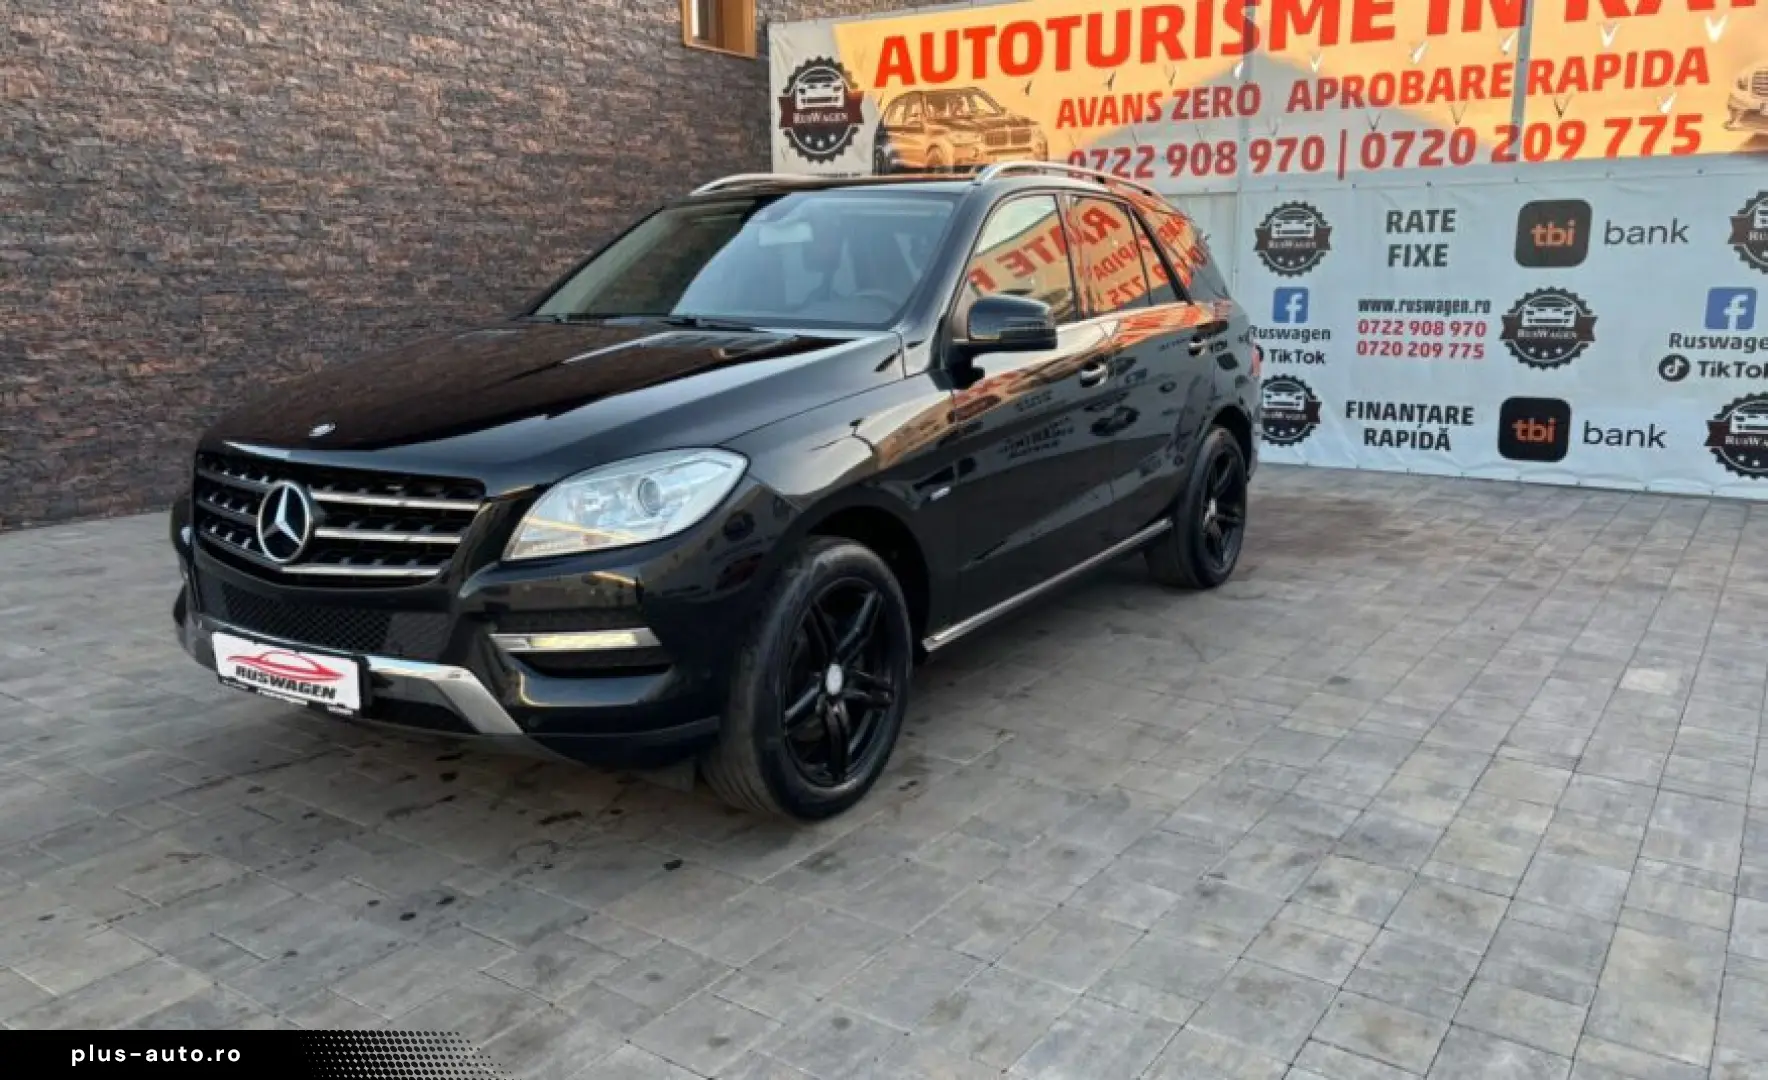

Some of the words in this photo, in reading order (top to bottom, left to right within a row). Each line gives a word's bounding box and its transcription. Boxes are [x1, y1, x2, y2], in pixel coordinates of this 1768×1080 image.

[874, 0, 1396, 87] AUTOTURISME
[1056, 91, 1163, 129] AVANS
[1171, 82, 1261, 121] ZERO
[1286, 62, 1514, 113] APROBARE
[1527, 47, 1710, 95] RAPIDA
[1067, 145, 1156, 178] 0722
[1165, 140, 1238, 177] 908
[1249, 135, 1325, 174] 970
[1361, 126, 1477, 169] 0720
[1491, 120, 1587, 163] 209
[1603, 113, 1703, 160] 775
[1386, 208, 1456, 234] RATE
[1530, 219, 1577, 247] tbi
[1604, 217, 1690, 245] bank
[1388, 243, 1449, 267] FIXE
[1358, 299, 1491, 317] www.ruswagen.ro
[1358, 320, 1403, 335] 0722
[1409, 320, 1444, 336] 908
[1450, 321, 1486, 337] 970
[1269, 348, 1326, 365] TikTok
[1357, 340, 1402, 356] 0720
[1408, 341, 1442, 358] 209
[1449, 342, 1484, 359] 775
[1513, 417, 1557, 443] tbi
[1583, 420, 1668, 449] bank
[236, 665, 337, 700] RUSWAGEN
